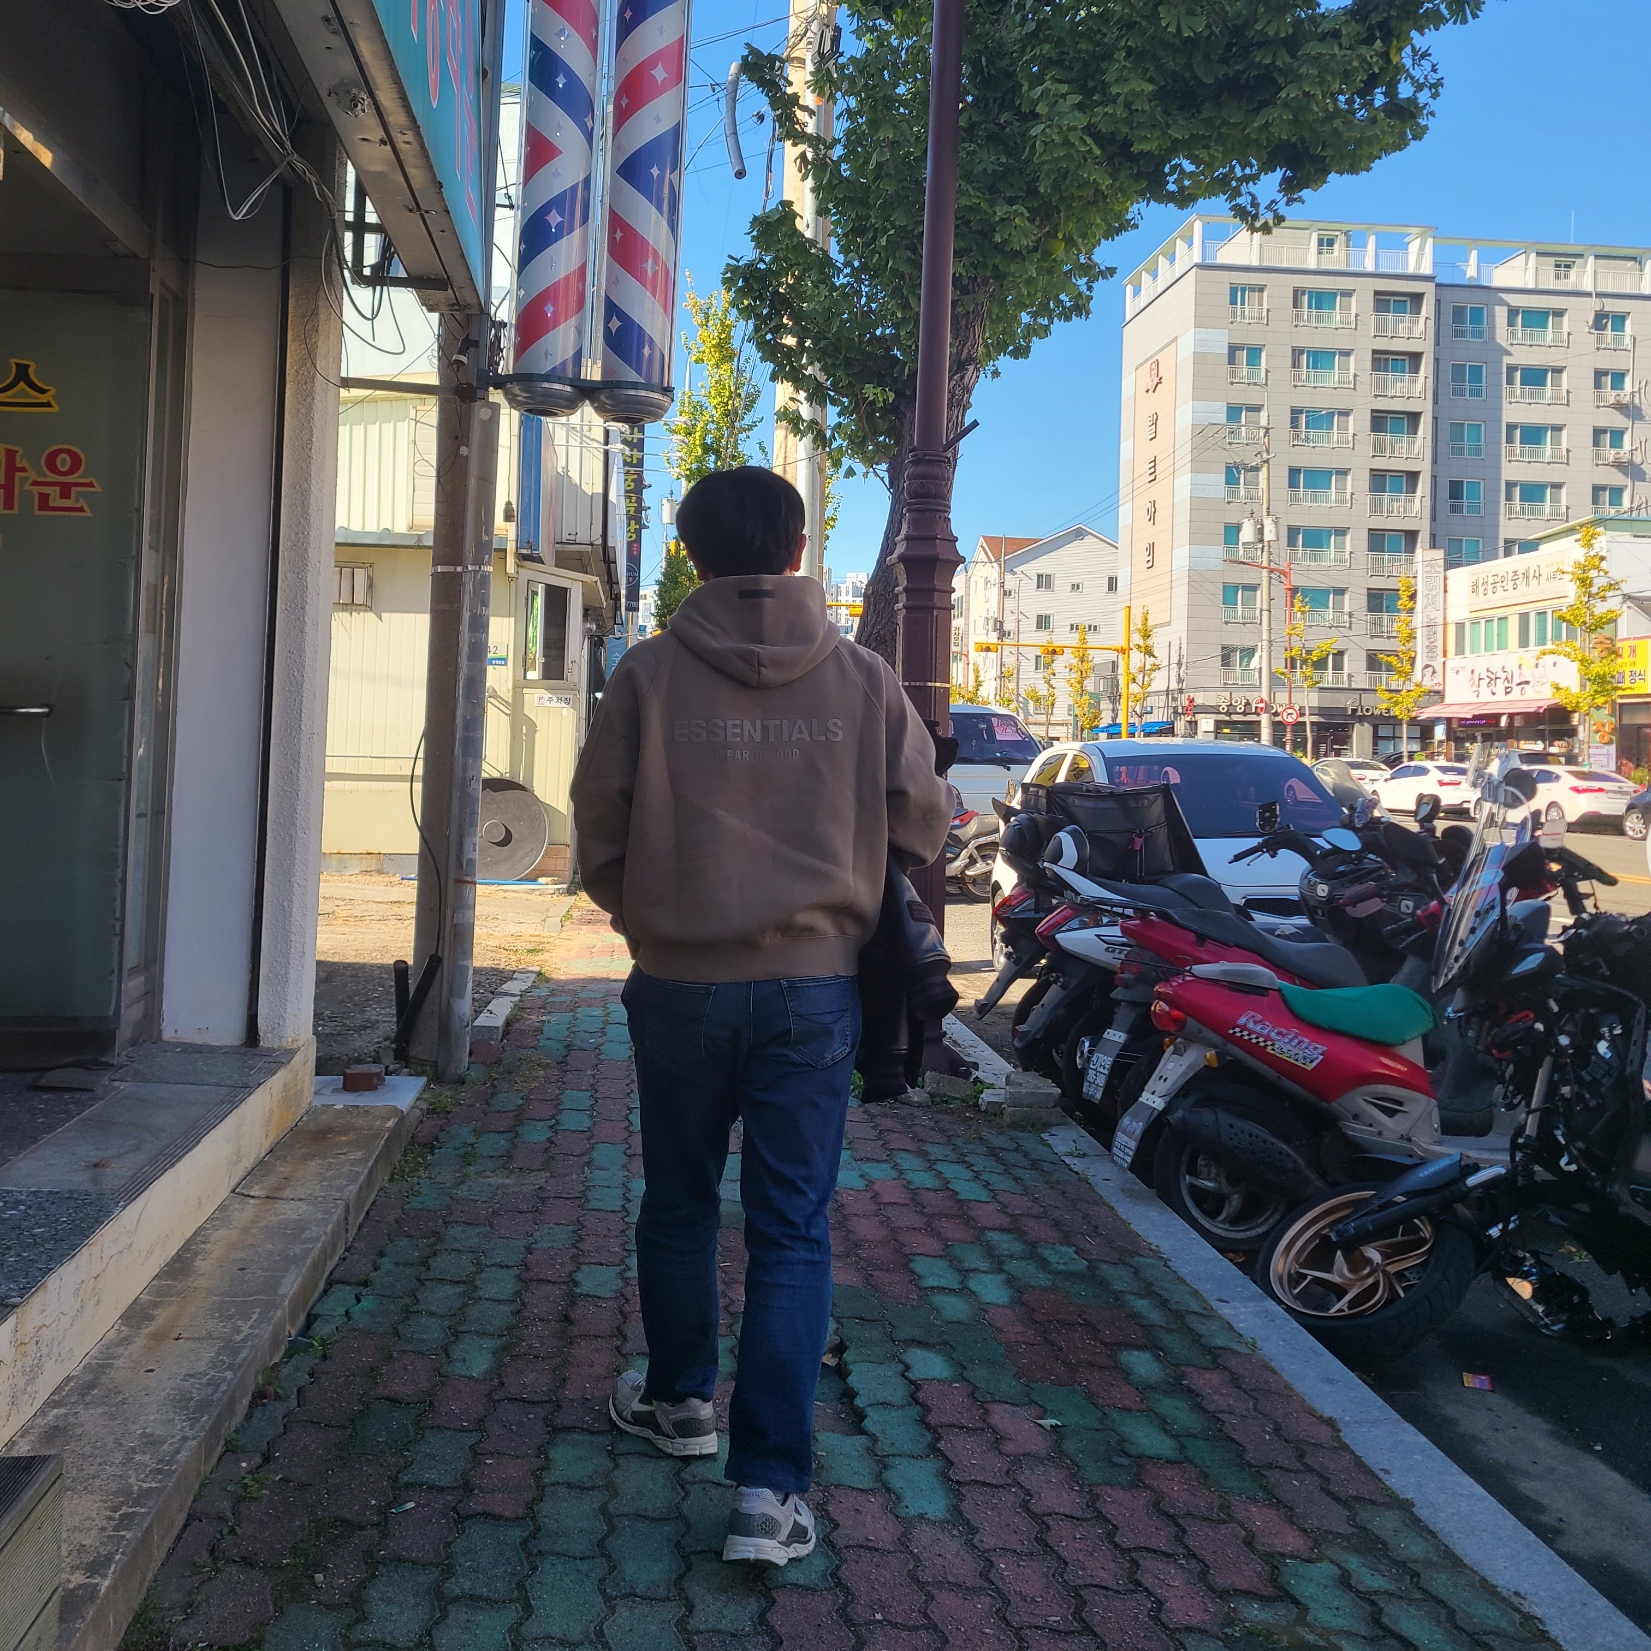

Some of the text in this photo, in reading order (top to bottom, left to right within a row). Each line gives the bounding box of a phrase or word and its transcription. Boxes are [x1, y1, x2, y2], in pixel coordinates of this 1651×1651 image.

[1471, 564, 1543, 598] 해성공인중개사
[1629, 669, 1646, 685] 정식
[546, 696, 571, 705] 주차장
[1217, 695, 1248, 713] 중앙
[673, 718, 844, 743] ESSENTIALS
[1236, 1010, 1328, 1058] Racing
